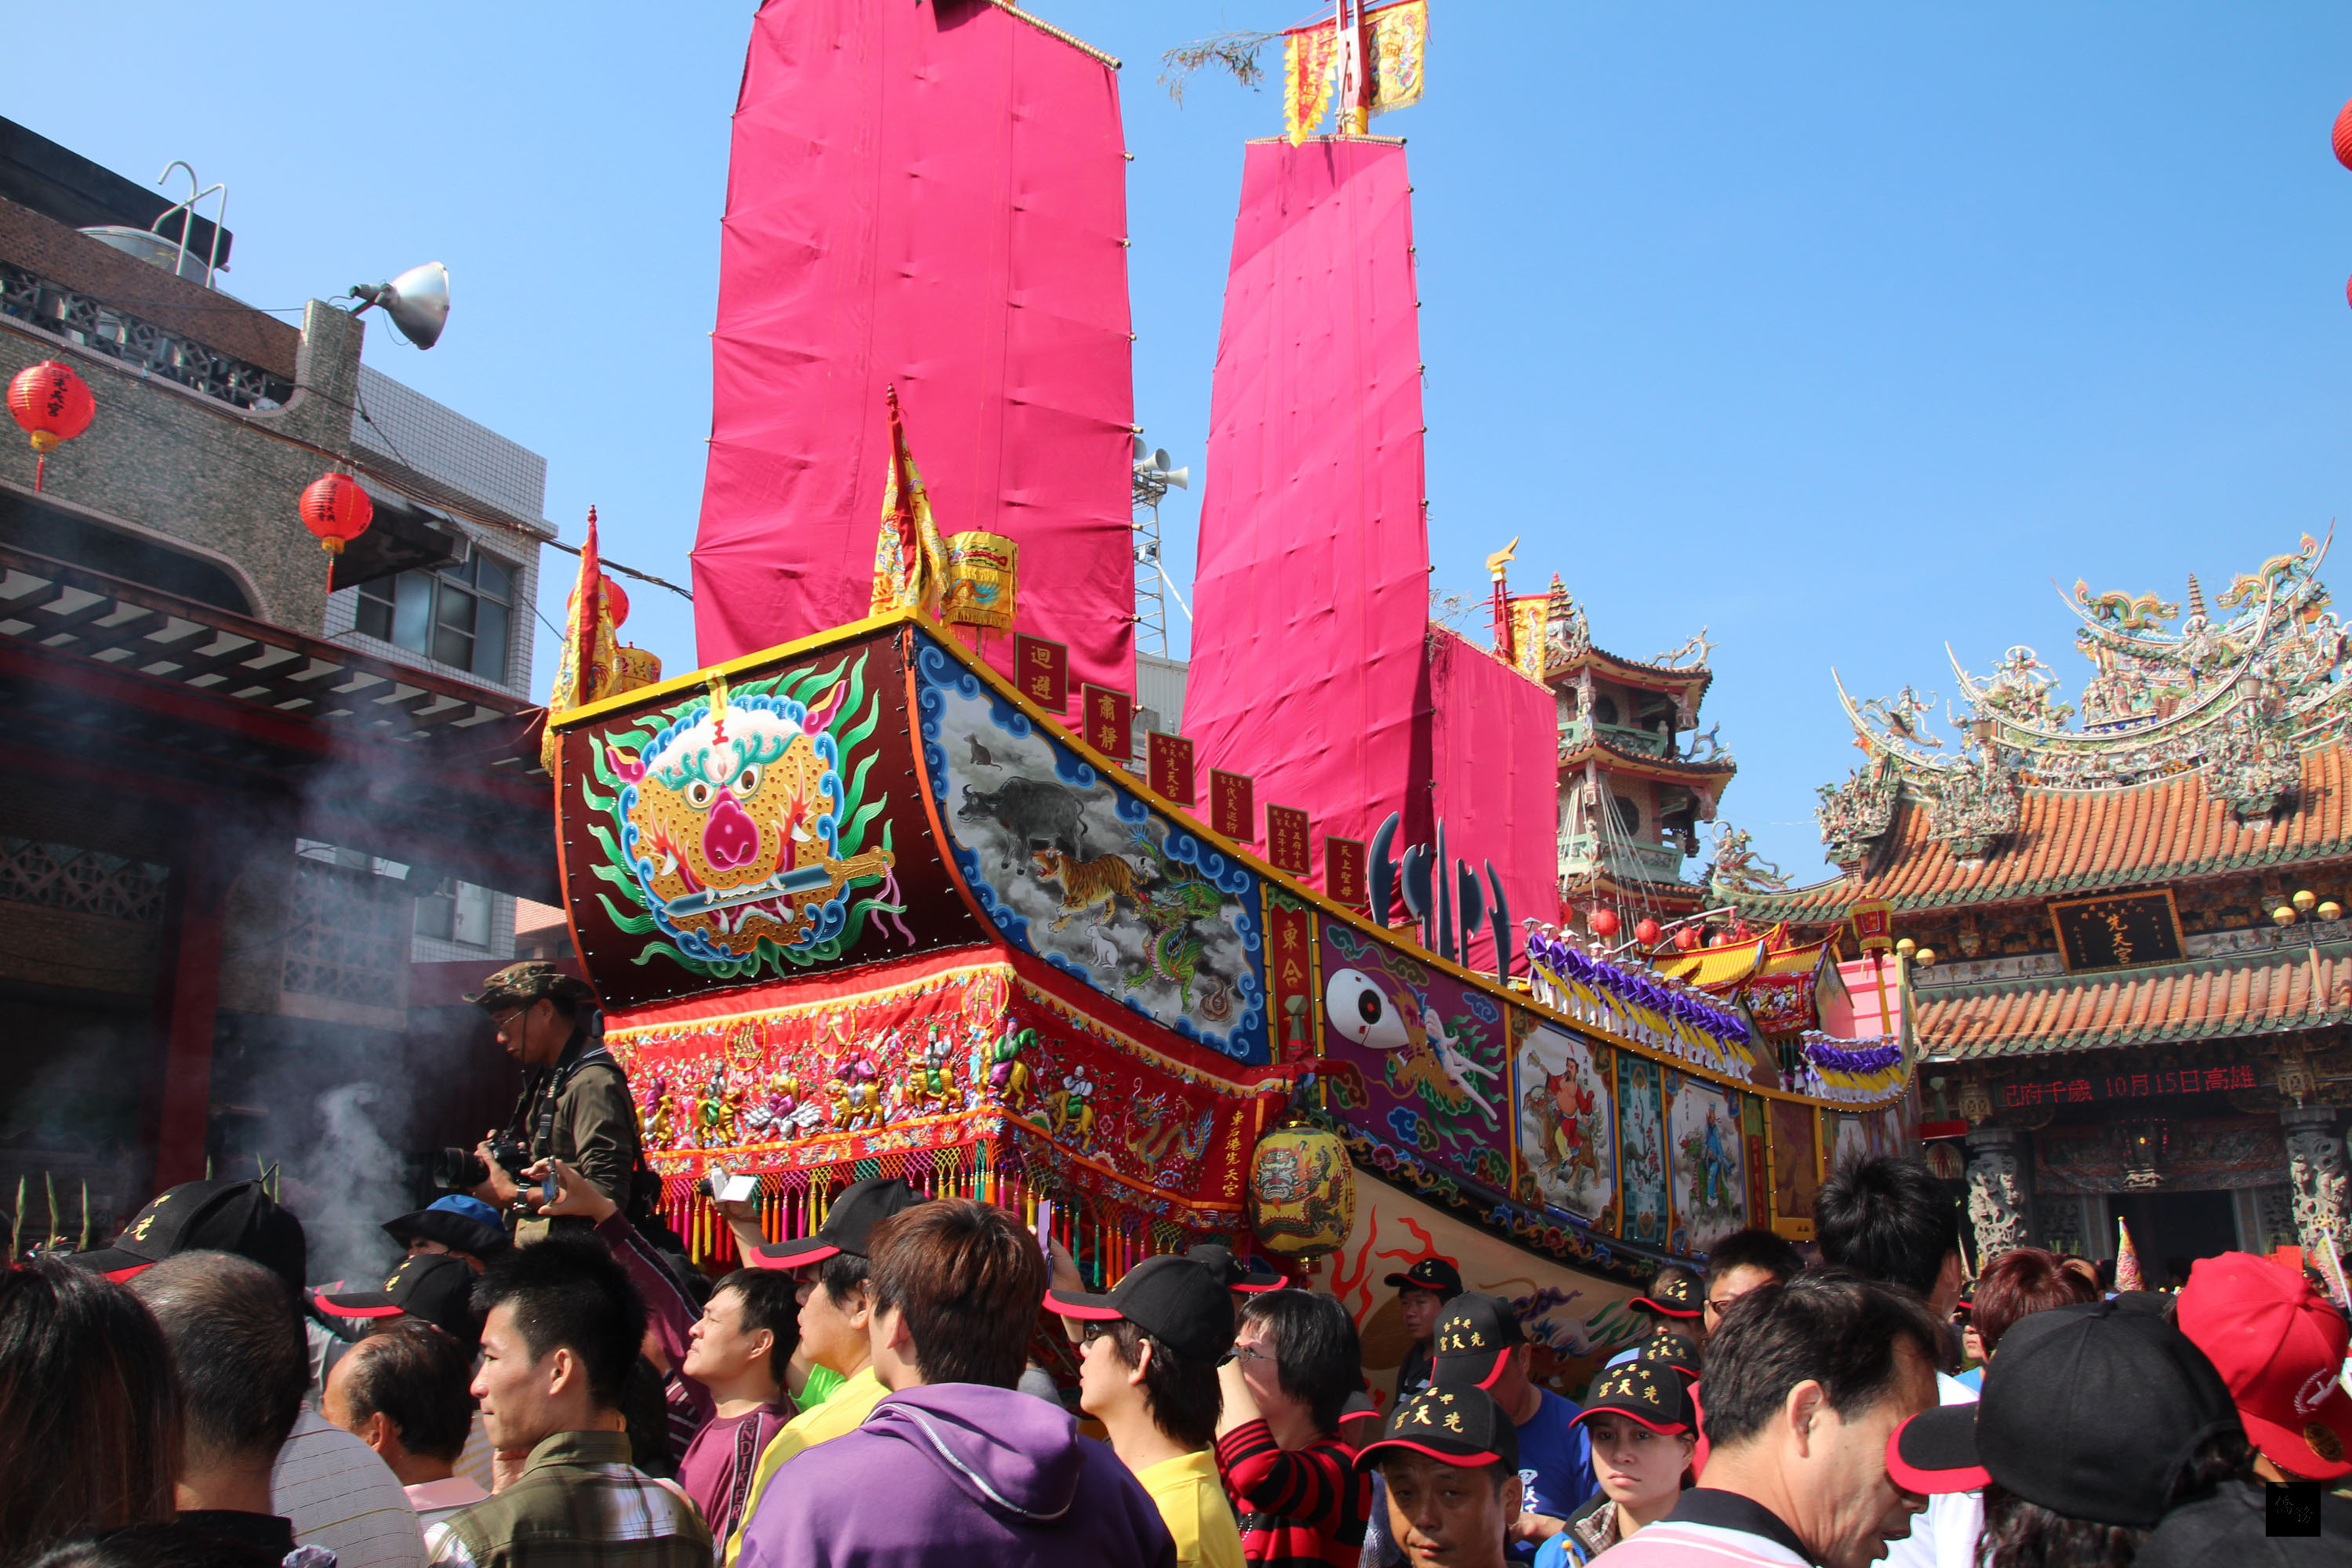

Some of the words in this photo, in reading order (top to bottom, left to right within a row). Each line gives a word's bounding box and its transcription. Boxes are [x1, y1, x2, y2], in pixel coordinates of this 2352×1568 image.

[1031, 645, 1054, 700] 迴避
[1098, 694, 1118, 751] 肅靜
[1166, 757, 1179, 798] 先天宮
[1225, 787, 1238, 833] 代天巡狩
[1339, 845, 1353, 898] 天上聖母
[2105, 913, 2134, 964] 先天宮
[1222, 1110, 1245, 1198] 東石港先天宮
[1439, 1331, 1486, 1352] 先天宮
[1599, 1378, 1661, 1406] 先天宮
[1394, 1403, 1465, 1434] 先天宮
